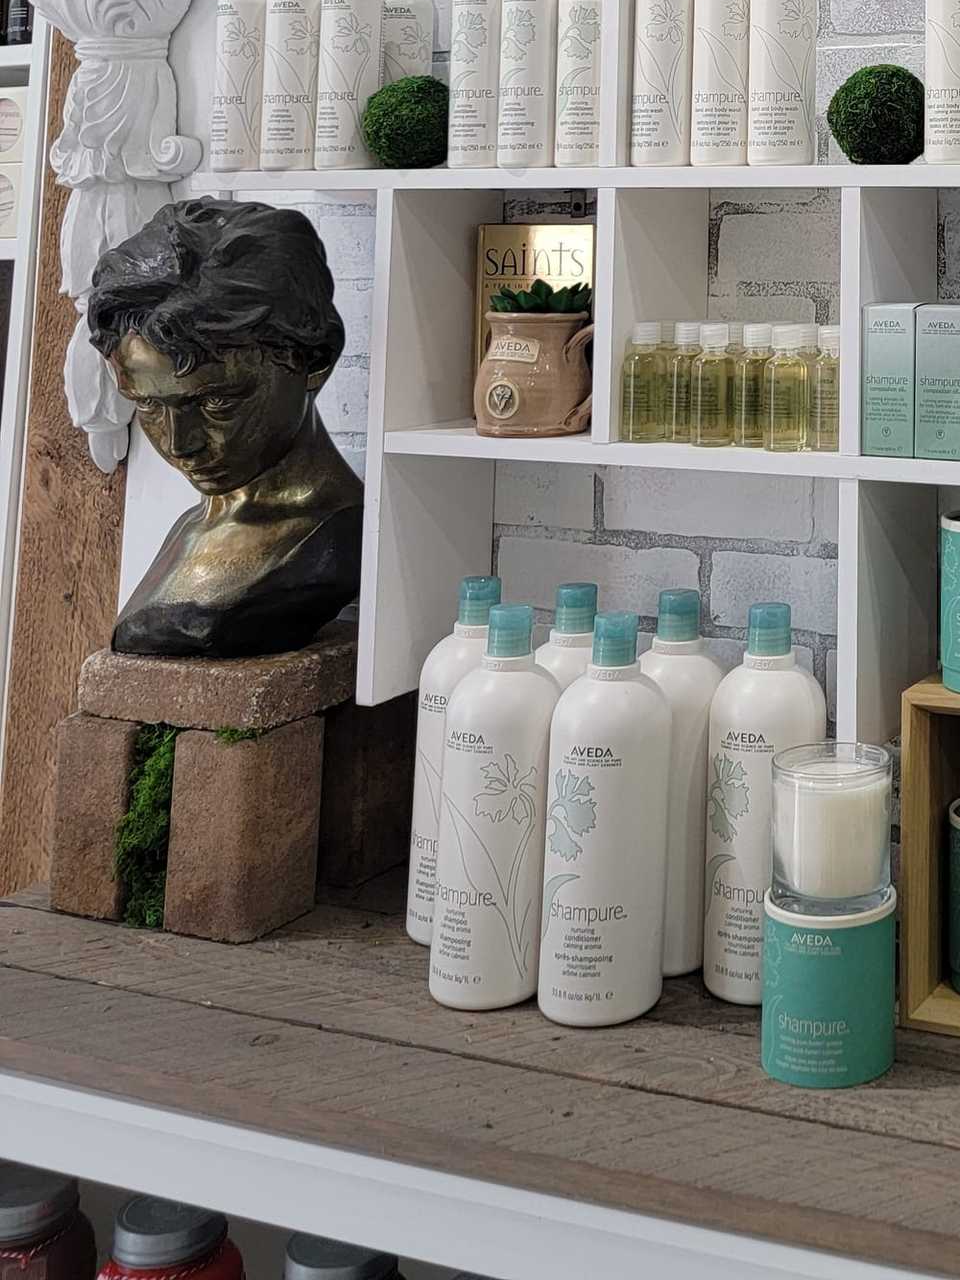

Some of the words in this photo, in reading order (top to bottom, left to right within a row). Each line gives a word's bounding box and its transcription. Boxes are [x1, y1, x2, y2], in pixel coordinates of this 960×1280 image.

[873, 320, 901, 328] AVEDA
[927, 321, 955, 330] AVEDA
[495, 341, 531, 353] AVEDA
[866, 373, 909, 387] shampure
[451, 730, 485, 745] AVEDA
[726, 730, 766, 744] AVEDA
[570, 745, 614, 758] AVEDA
[713, 878, 765, 907] shampu
[551, 898, 628, 927] shampure
[791, 932, 833, 946] AVEDA
[778, 1011, 850, 1039] shampure
